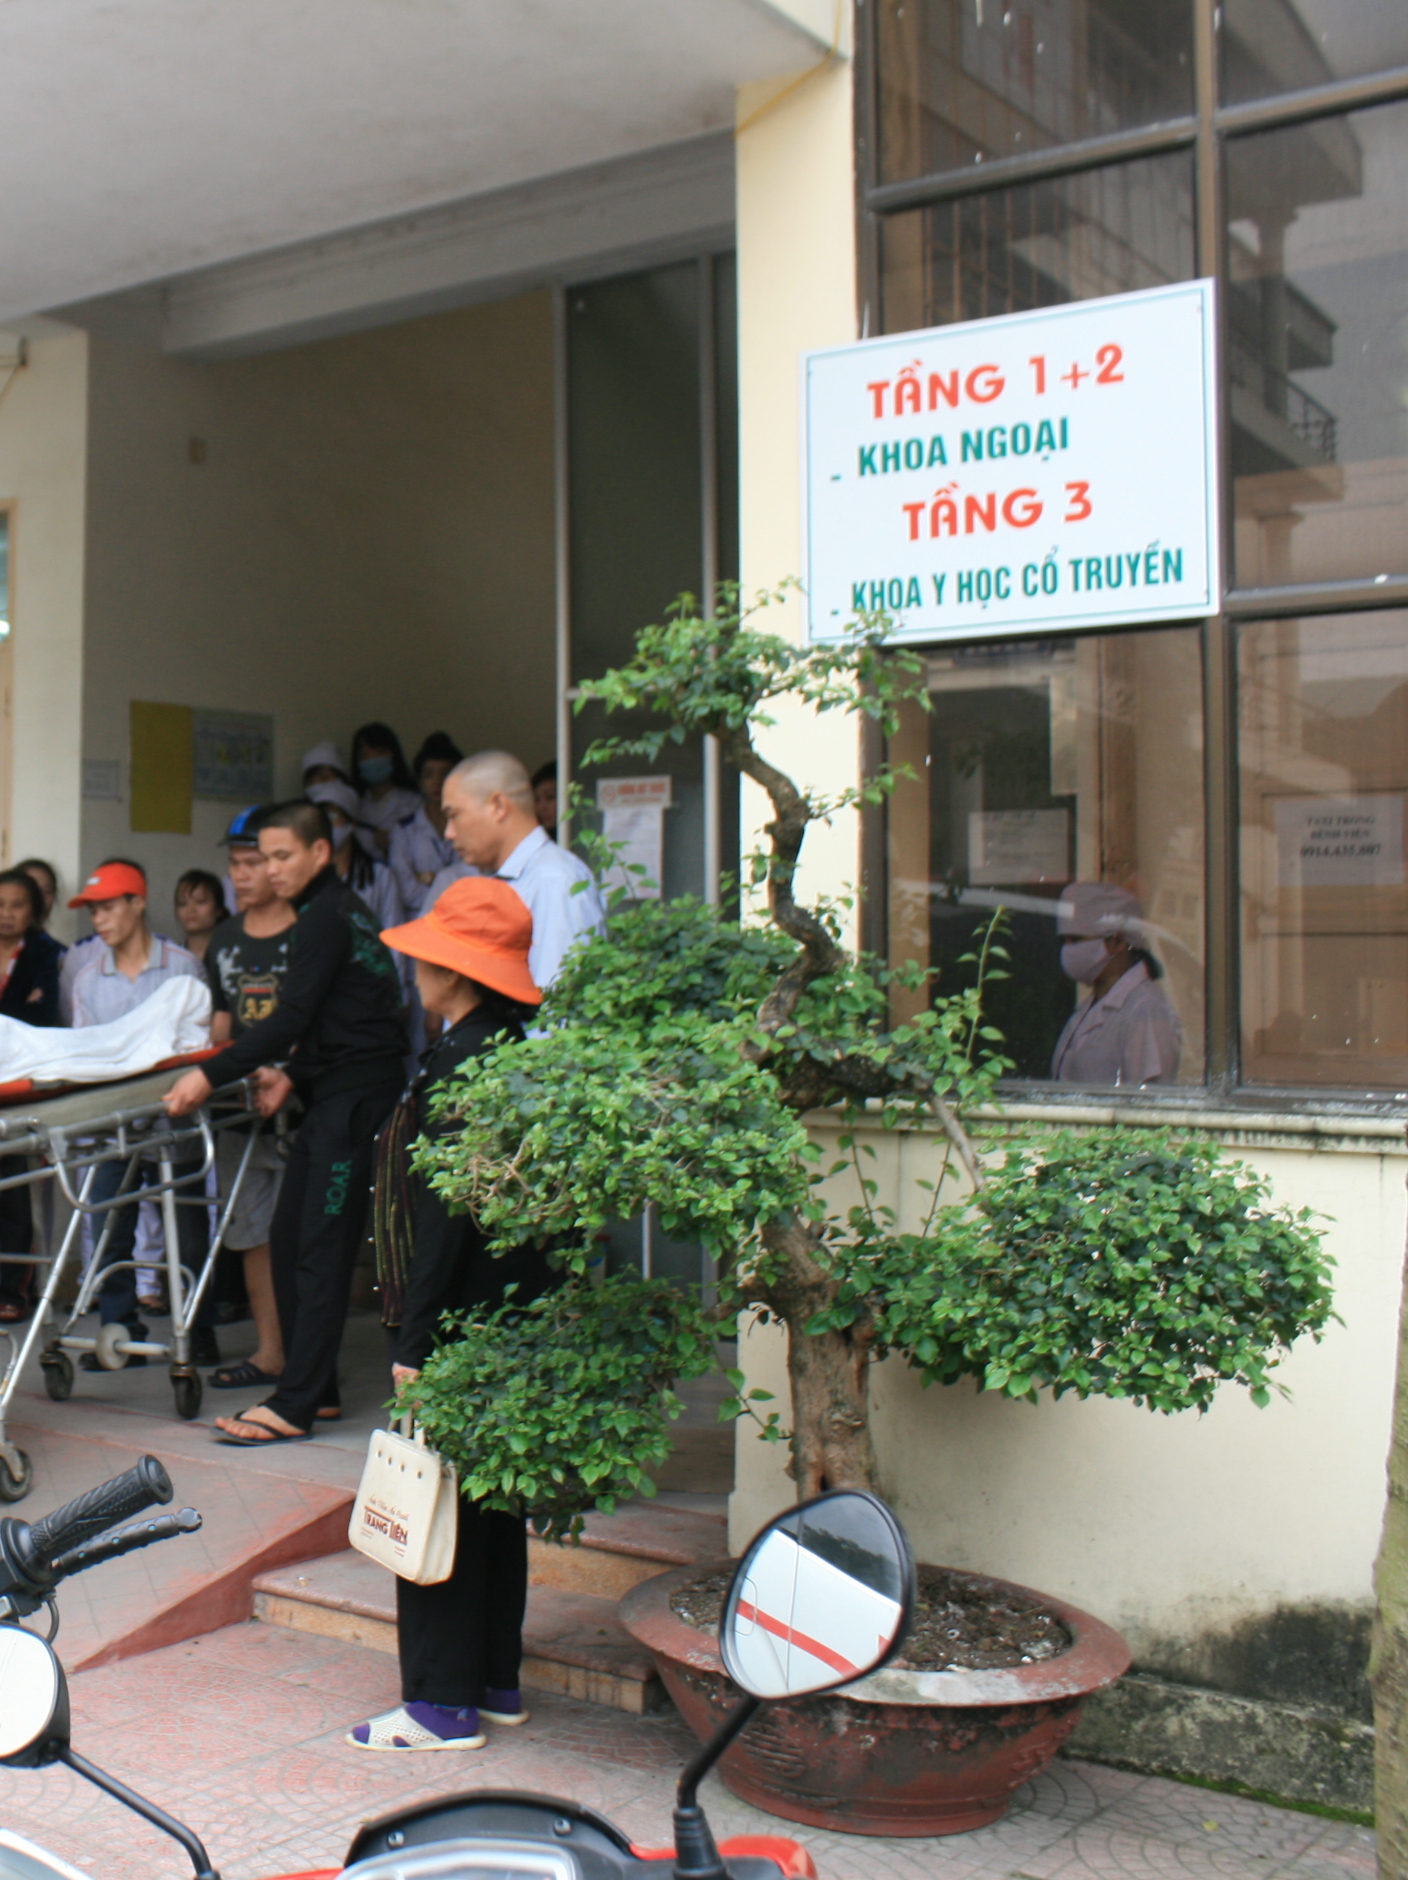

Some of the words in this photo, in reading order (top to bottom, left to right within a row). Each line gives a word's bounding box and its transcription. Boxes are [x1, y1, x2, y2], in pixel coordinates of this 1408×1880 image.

[866, 358, 1006, 419] TẦNG
[858, 433, 949, 478] KHOA
[959, 415, 1070, 463] NGOẠI
[901, 481, 1044, 541] TẦNG
[1063, 480, 1094, 524] 3
[852, 575, 923, 613] KHOA
[932, 571, 947, 605] Y
[956, 566, 1012, 610] HỌC
